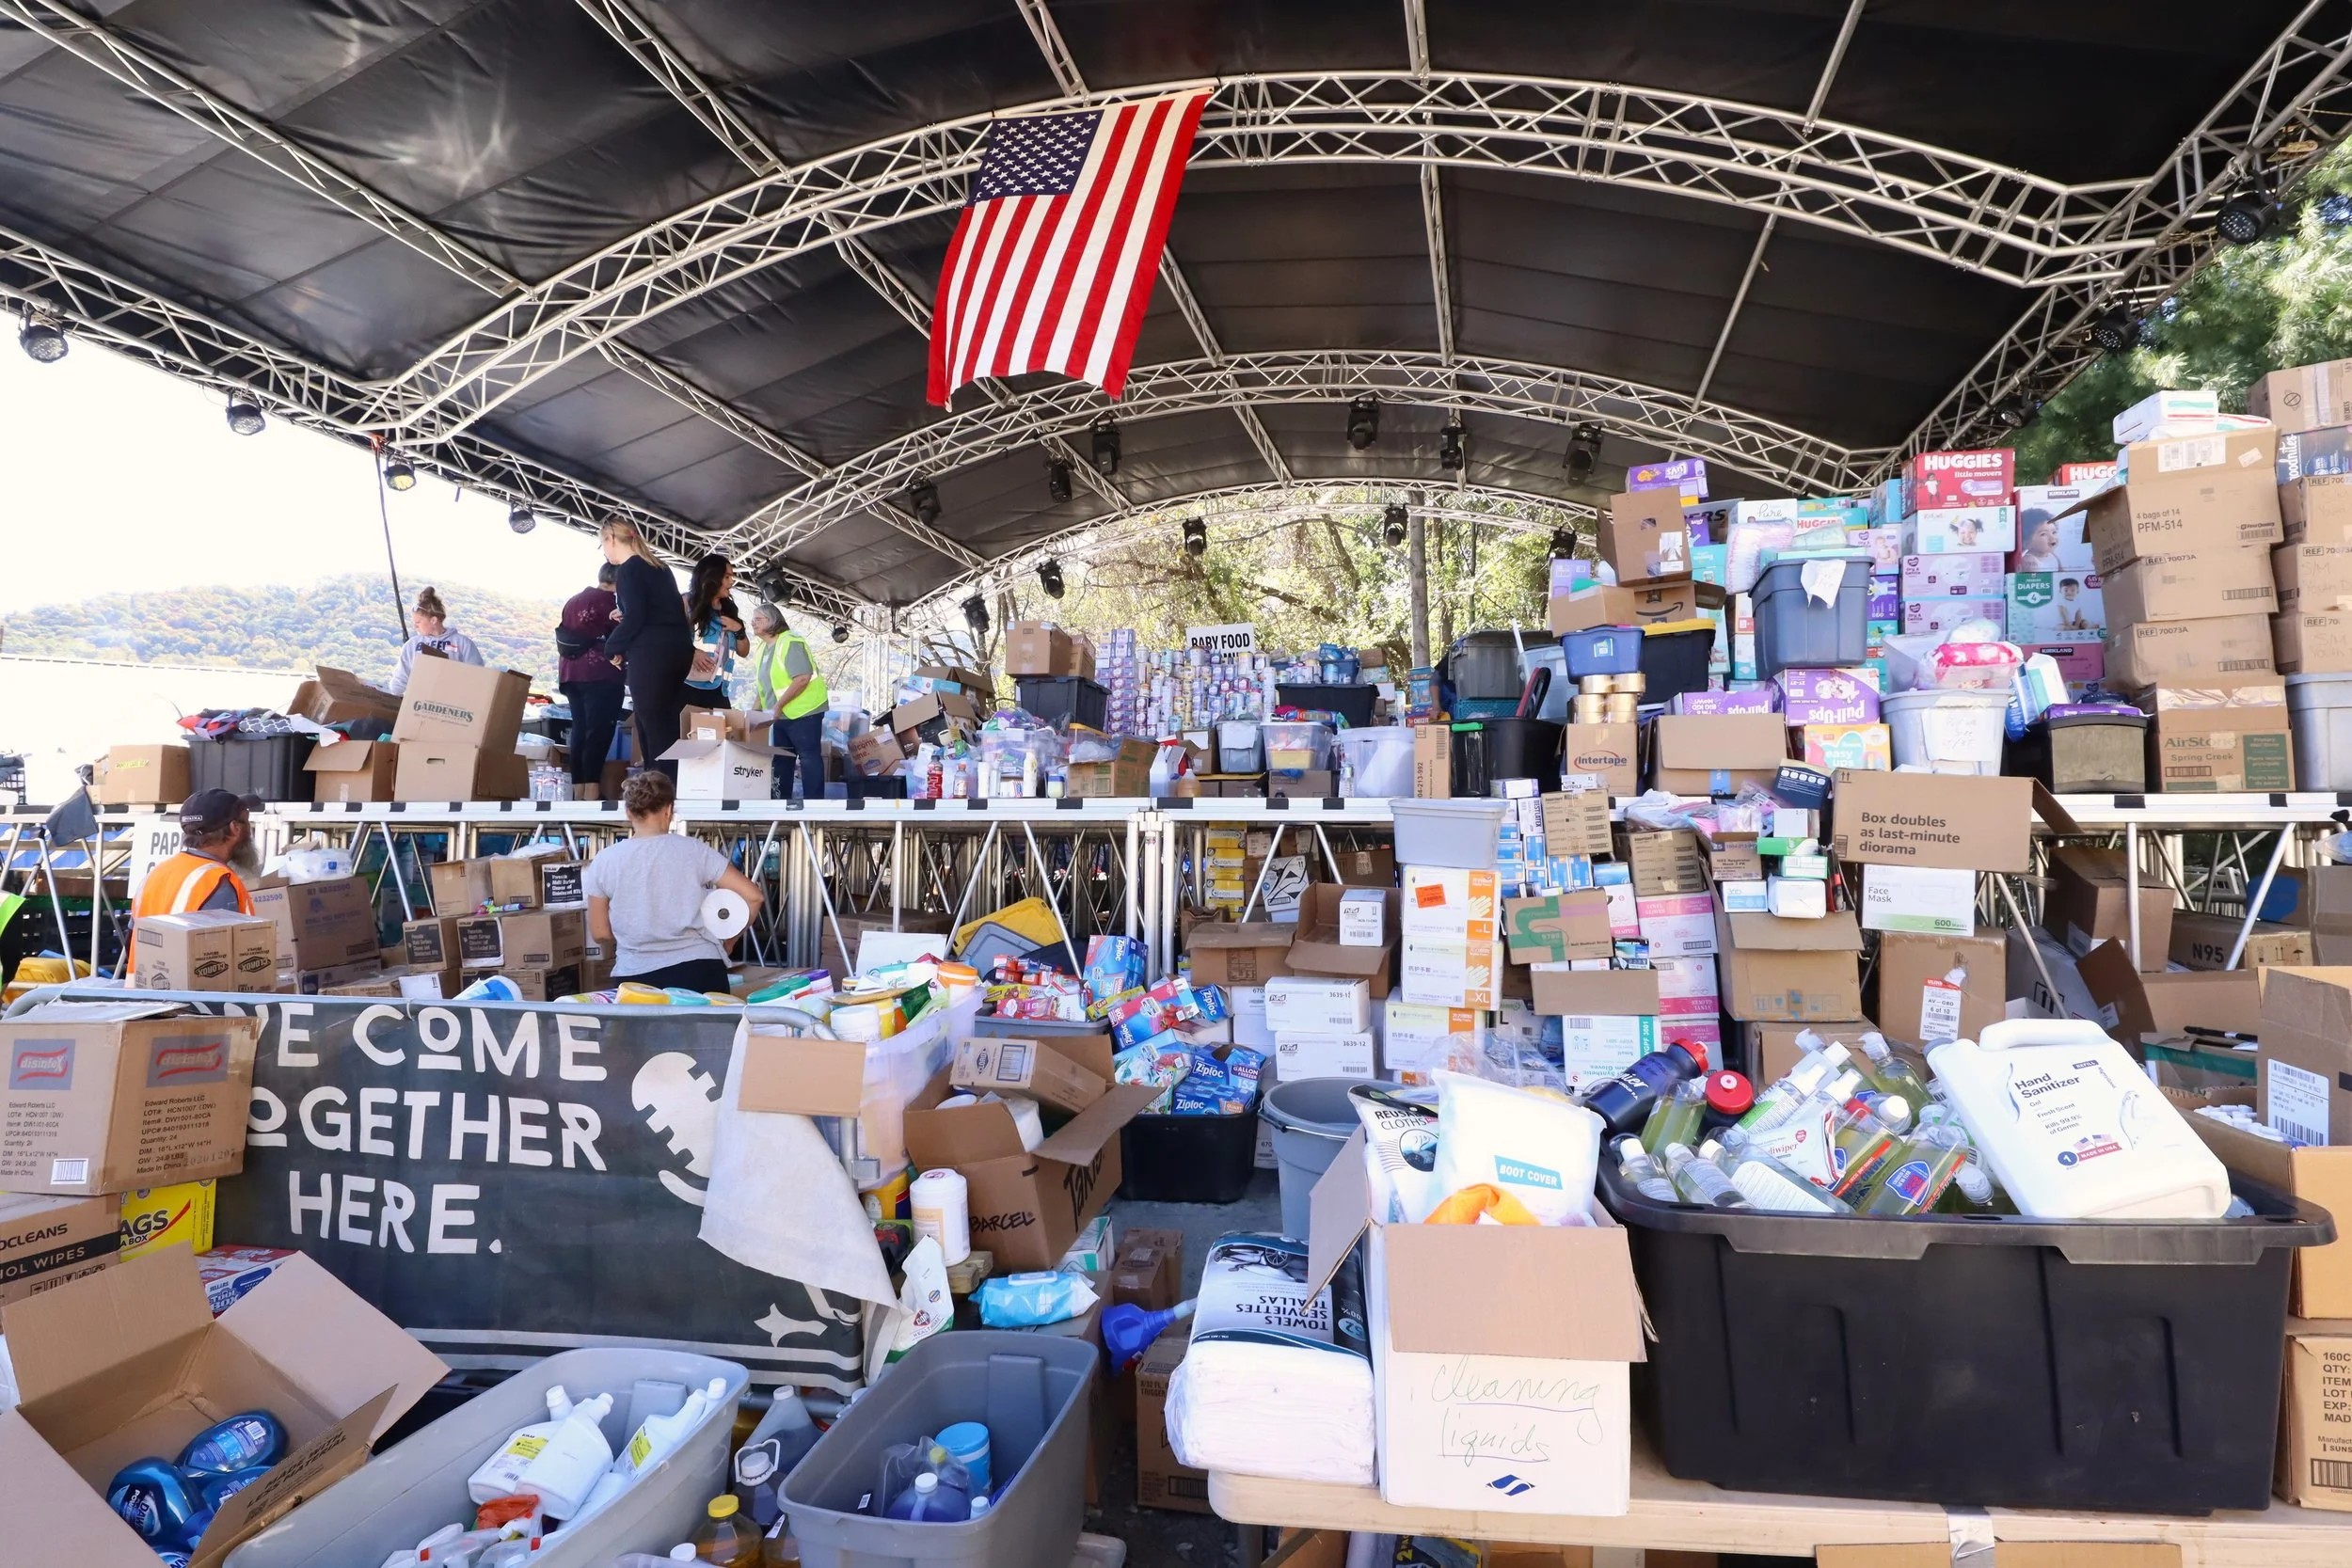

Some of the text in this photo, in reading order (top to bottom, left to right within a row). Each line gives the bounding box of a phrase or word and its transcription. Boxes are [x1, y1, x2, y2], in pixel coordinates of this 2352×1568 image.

[1924, 452, 2003, 470] HUGGIES
[2069, 467, 2117, 481] HUGG
[2142, 511, 2161, 520] bags
[2137, 520, 2183, 533] PFM-514
[2159, 626, 2188, 635] 70073A
[1191, 633, 1249, 649] BABY FOOD
[1579, 755, 1628, 767] Intertape
[1825, 751, 1852, 760] easy
[2171, 753, 2202, 762] Spring
[734, 765, 764, 779] stryker
[1861, 812, 1947, 828] Box doubles
[1860, 828, 1961, 844] as last-minute
[151, 832, 183, 855] PAP
[1859, 841, 1916, 855] diorama
[1868, 895, 1892, 903] Mask
[1484, 923, 1490, 933] L
[1115, 937, 1126, 961] Ziploc
[2192, 942, 2224, 962] N95
[197, 962, 227, 976] CLOROX
[240, 958, 270, 971] CLOROX
[1202, 990, 1217, 1016] Ziploc
[1474, 992, 1490, 1003] XL
[1120, 1023, 1136, 1045] Ziploc
[352, 1004, 609, 1082] COME
[1195, 1062, 1224, 1079] Ziploc
[1233, 1066, 1259, 1076] GALLON
[2075, 1060, 2095, 1069] REFILL
[1237, 1080, 1256, 1090] 152
[2015, 1072, 2052, 1090] Hand
[2021, 1076, 2081, 1099] Sanitizer
[1176, 1098, 1204, 1111] Ziploc
[2037, 1102, 2075, 1118] Fresh Scent
[1375, 1110, 1424, 1119] REUSA
[247, 1085, 609, 1172] OGETHER
[1381, 1117, 1427, 1130] CLOTHS
[2045, 1121, 2059, 1130] Kills
[2080, 1149, 2097, 1159] MADE
[136, 1165, 154, 1174] Made
[164, 1162, 182, 1170] China
[1500, 1164, 1558, 1185] BOOT COVER
[289, 1170, 502, 1254] HERE.
[129, 1234, 149, 1245] BOX
[33, 1246, 86, 1270] WIPES
[1260, 1295, 1327, 1309] TALLAS
[1265, 1316, 1328, 1331] TOWELS
[2323, 1353, 2352, 1362] 160C
[2323, 1364, 2351, 1374] QTY:
[2323, 1377, 2352, 1386] ITEM
[2323, 1389, 2345, 1398] LOT
[2324, 1402, 2351, 1411] EXP:
[2324, 1413, 2352, 1423] MAD
[1440, 1407, 1551, 1468] liquids
